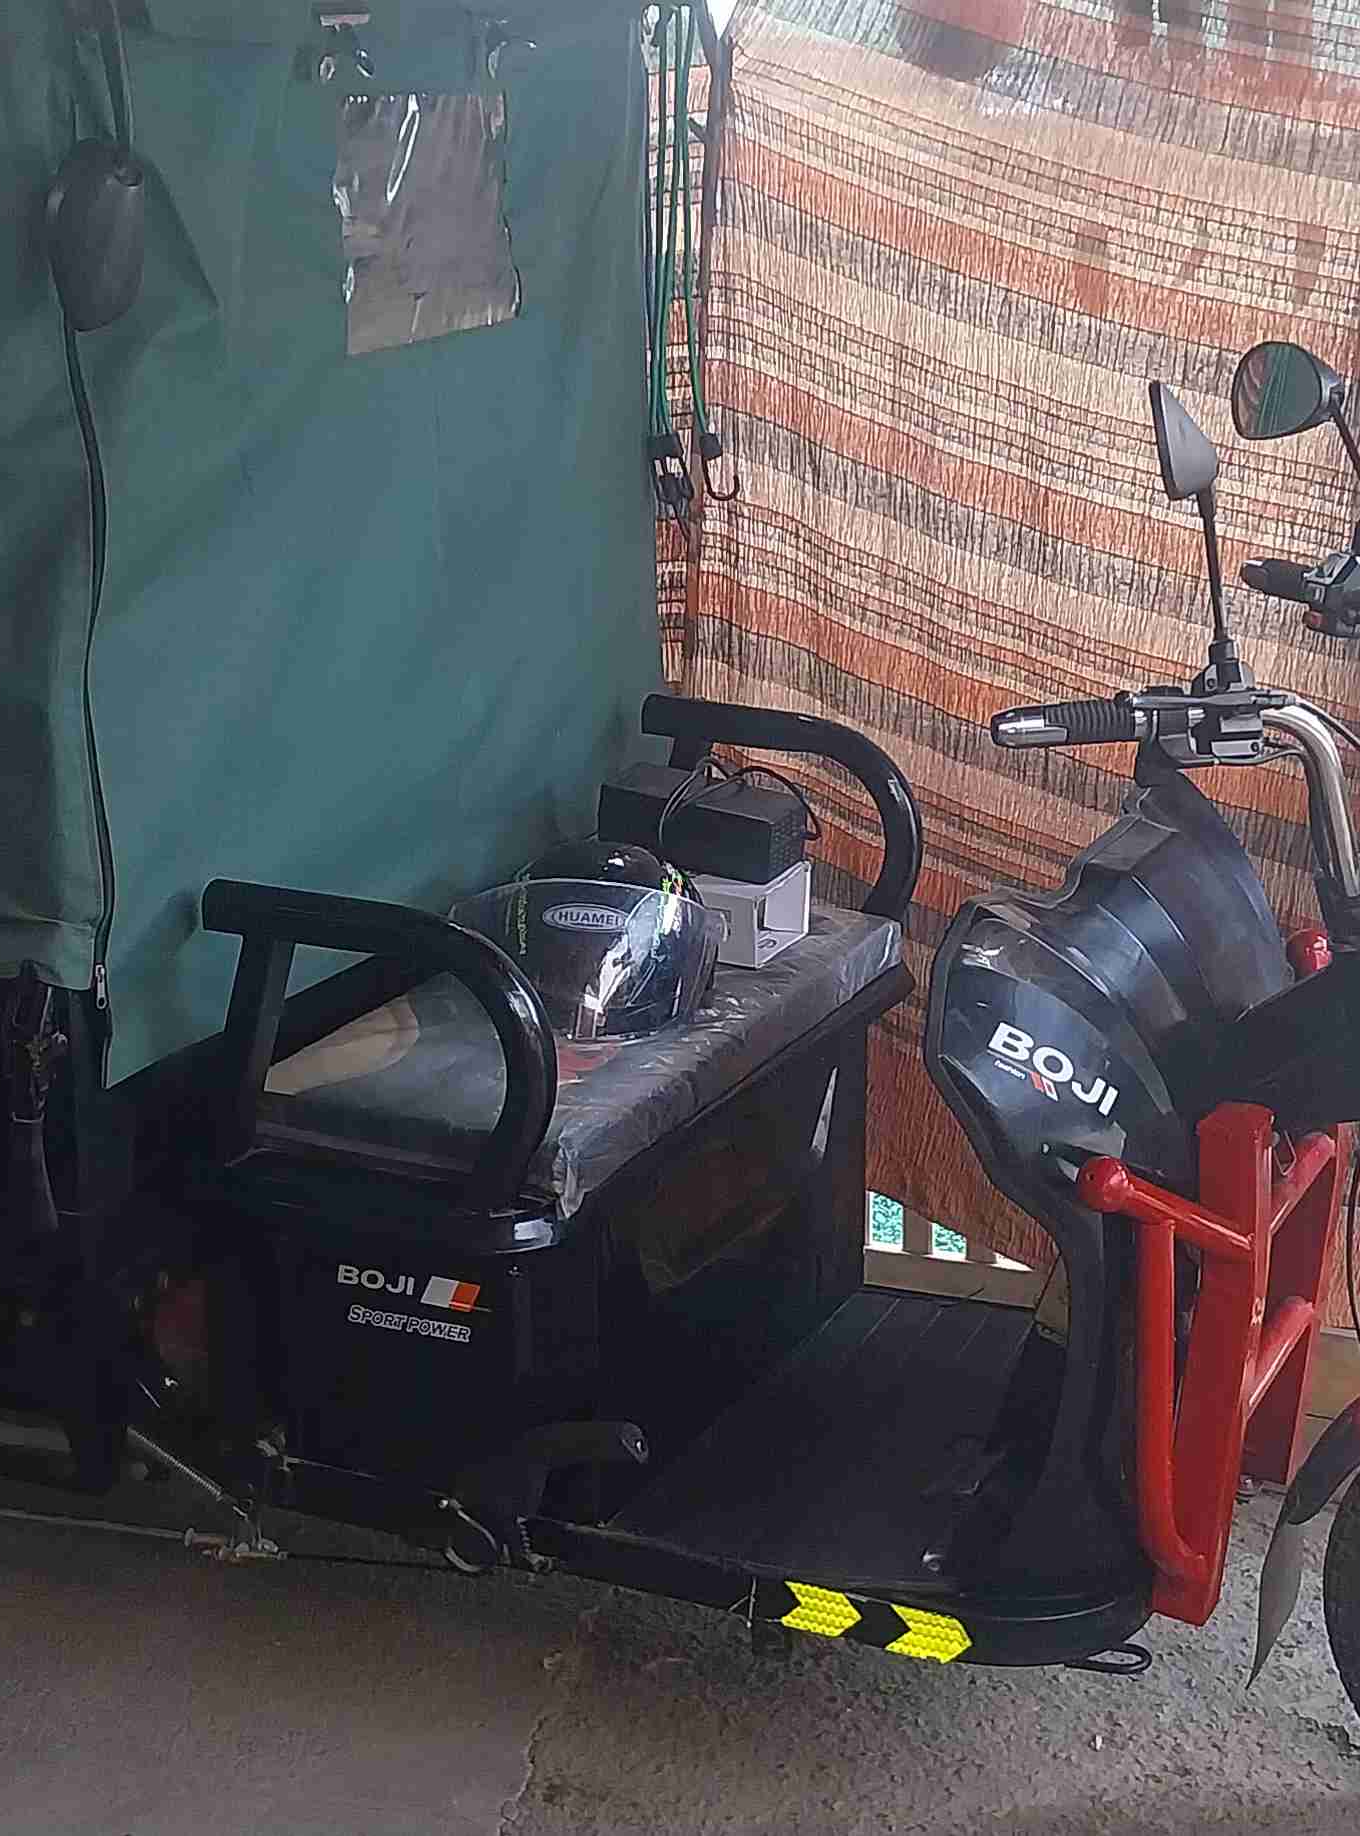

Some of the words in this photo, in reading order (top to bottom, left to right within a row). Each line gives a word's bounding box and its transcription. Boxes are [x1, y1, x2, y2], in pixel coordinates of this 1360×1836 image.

[558, 911, 619, 926] HUAMEI
[987, 1021, 1119, 1117] BOJI
[336, 1264, 416, 1296] BOJI
[406, 1316, 472, 1343] POWER
